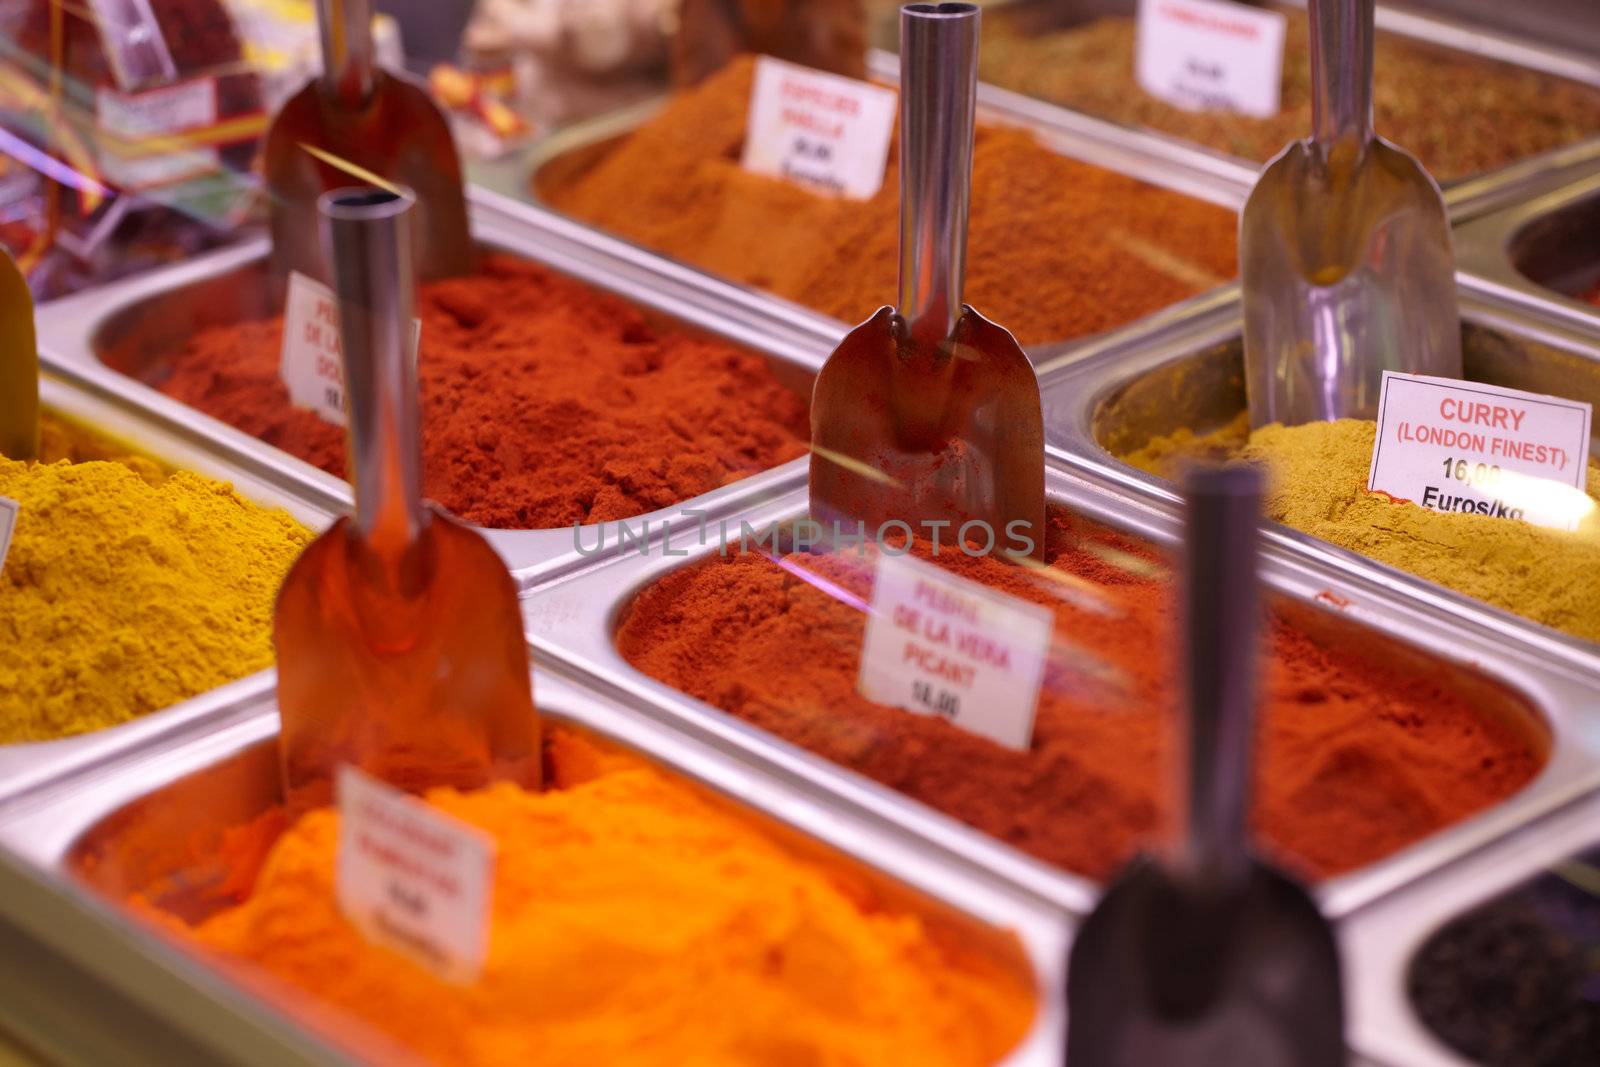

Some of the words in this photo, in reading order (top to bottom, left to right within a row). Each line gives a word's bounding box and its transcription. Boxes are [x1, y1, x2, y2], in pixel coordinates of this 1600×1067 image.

[1440, 398, 1526, 432] CURRY
[1397, 422, 1486, 455] (LONDON
[1491, 437, 1568, 471] FINEST)
[893, 602, 920, 634] DE
[924, 616, 950, 645] LA
[955, 628, 1012, 671] VERA
[903, 641, 977, 690] PICANT
